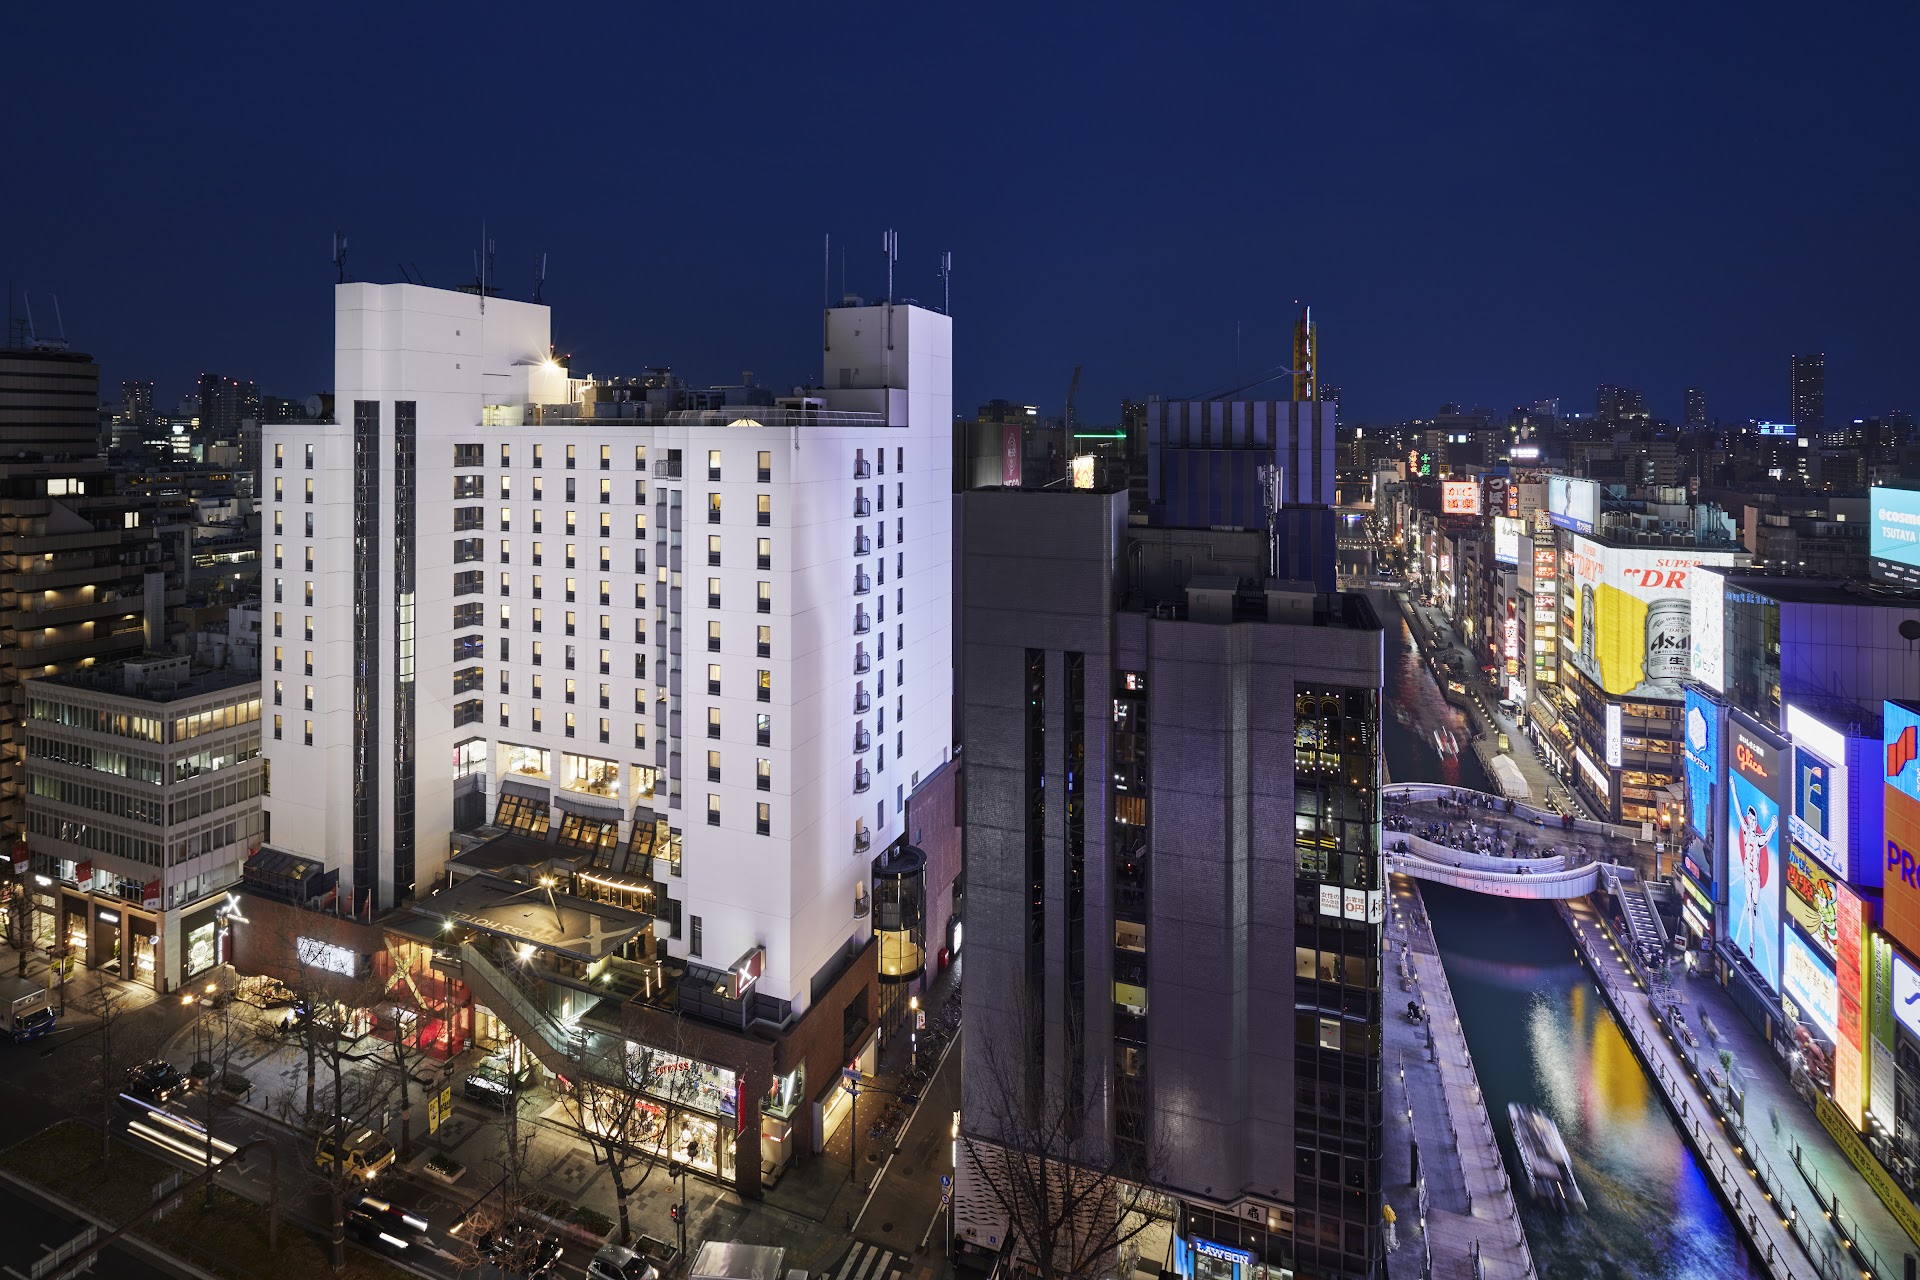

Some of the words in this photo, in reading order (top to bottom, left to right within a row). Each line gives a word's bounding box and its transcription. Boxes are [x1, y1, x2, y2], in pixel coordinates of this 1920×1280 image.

[1447, 486, 1473, 497] かに
[1488, 477, 1506, 527] つぼら
[1881, 526, 1916, 543] TSUTAYA
[1656, 558, 1702, 568] SUPER
[1624, 568, 1692, 589] “DR
[1669, 656, 1685, 666] 生
[1737, 744, 1768, 778] Glico
[1787, 814, 1843, 873] 日商エステム
[1789, 850, 1813, 879] かぜに
[1786, 863, 1815, 902] 改源
[1321, 891, 1340, 900] 女性の
[1345, 895, 1365, 904] お客様
[1345, 903, 1365, 914] 0円
[452, 911, 500, 931] HOTEL
[1196, 1242, 1249, 1265] LAWSON
